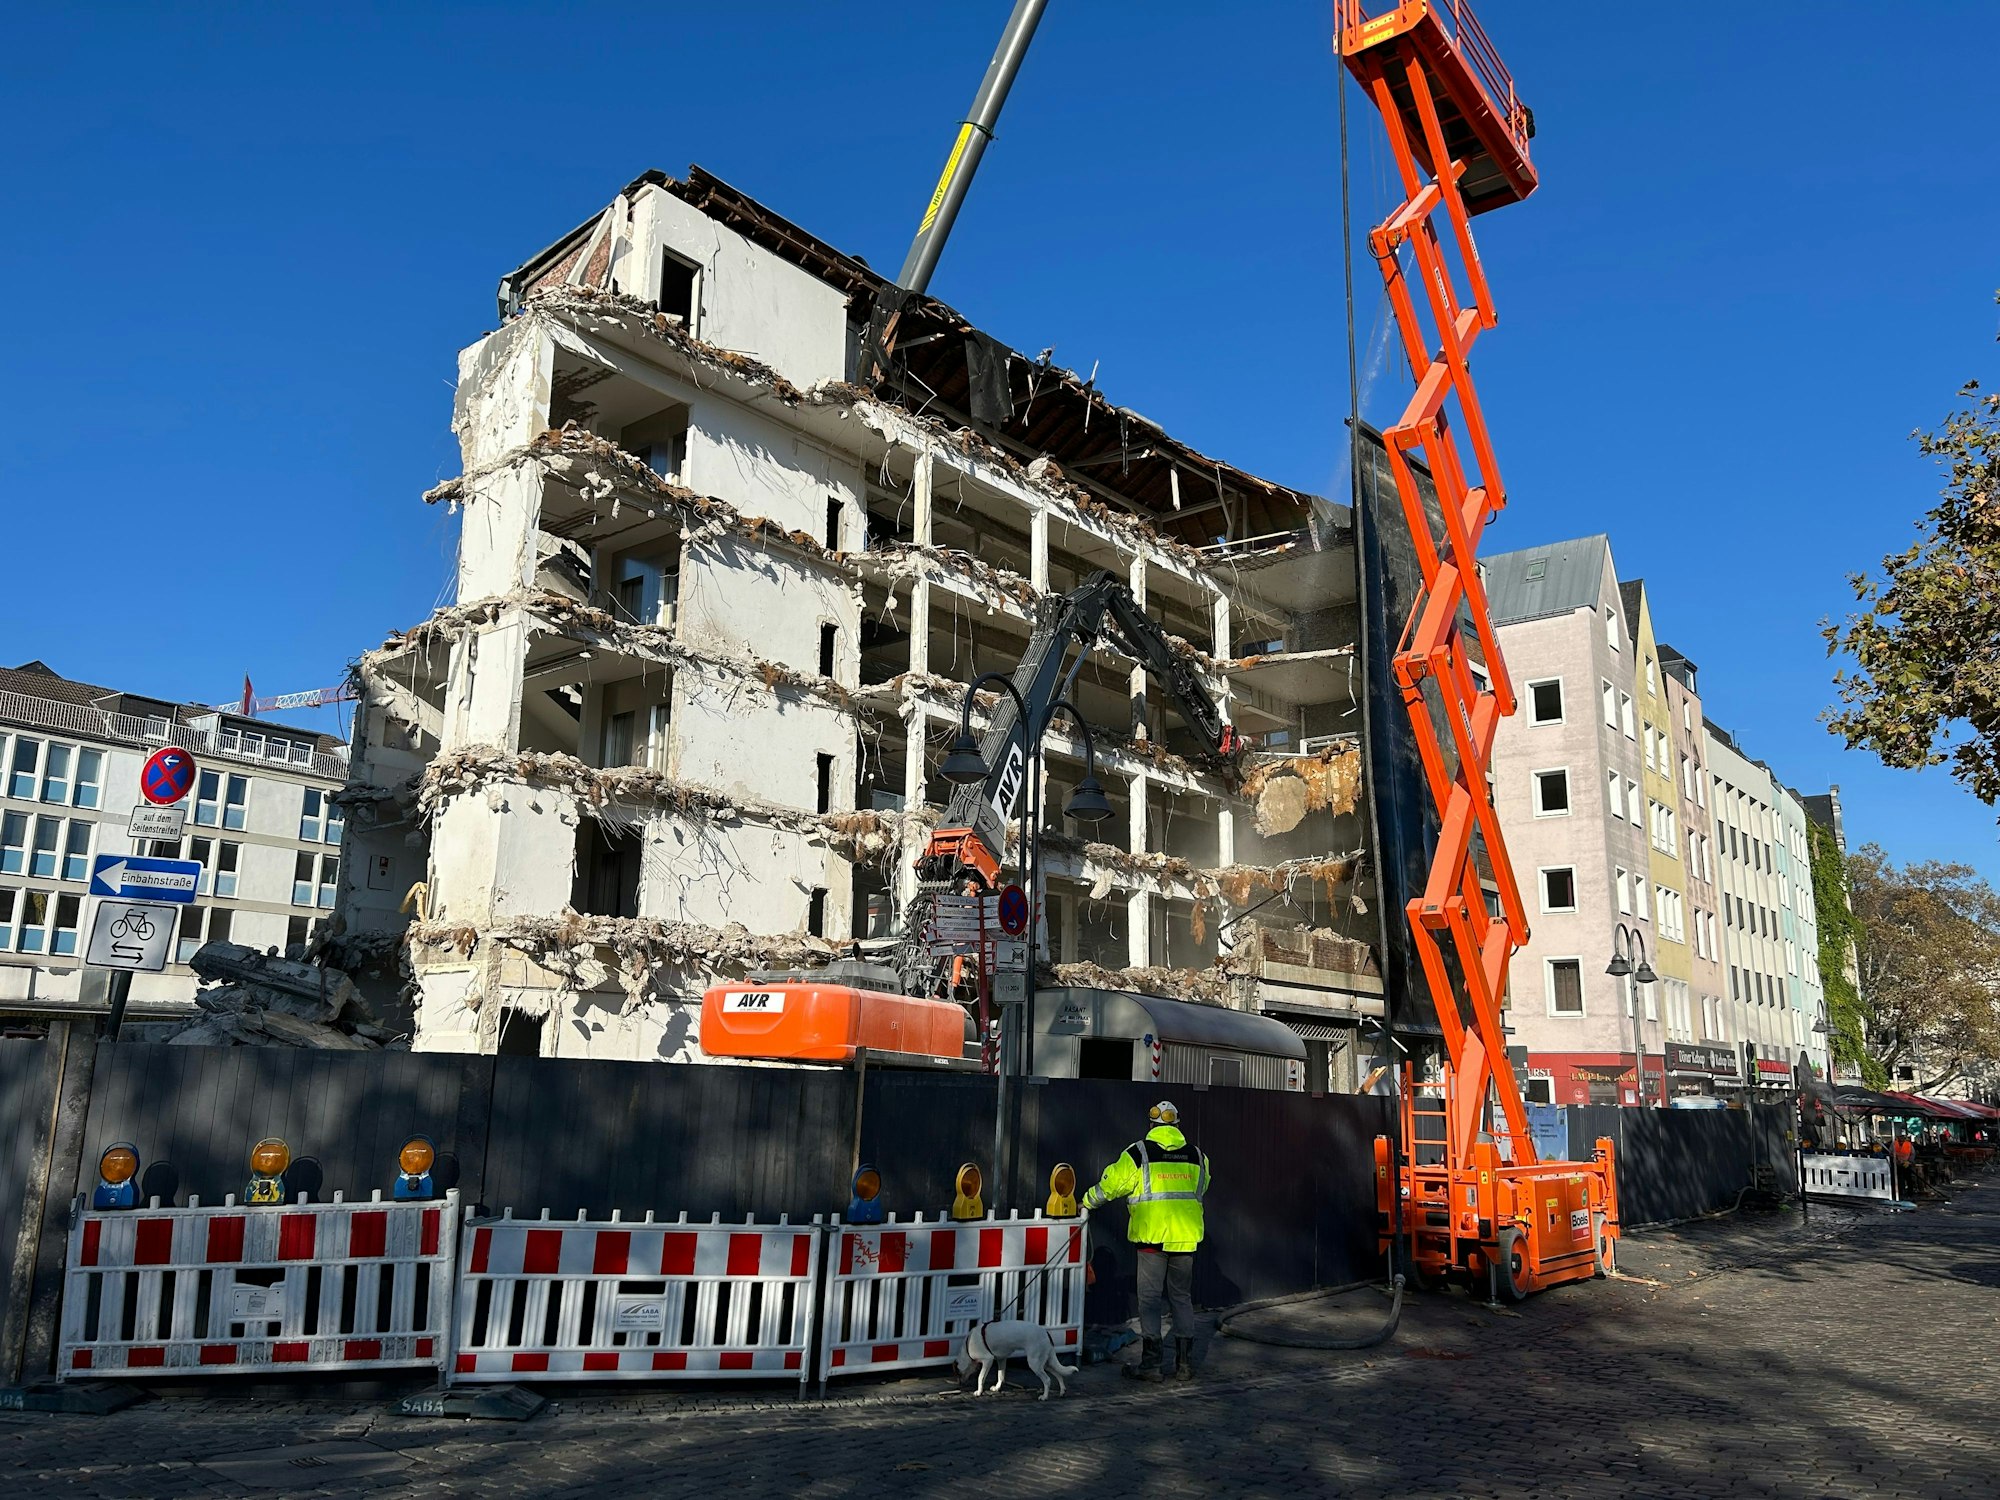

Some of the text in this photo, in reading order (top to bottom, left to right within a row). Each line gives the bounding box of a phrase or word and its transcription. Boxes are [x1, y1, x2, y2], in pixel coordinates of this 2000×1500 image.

[932, 187, 944, 206] HKV
[998, 752, 1023, 815] AVR
[143, 813, 172, 823] auf dem
[132, 823, 178, 835] Seitenstreifen
[121, 872, 192, 887] Einbahnstraße
[737, 994, 770, 1007] AVR
[1528, 1068, 1552, 1077] URST
[1572, 1214, 1589, 1227] Boels
[401, 1399, 444, 1412] SABA
